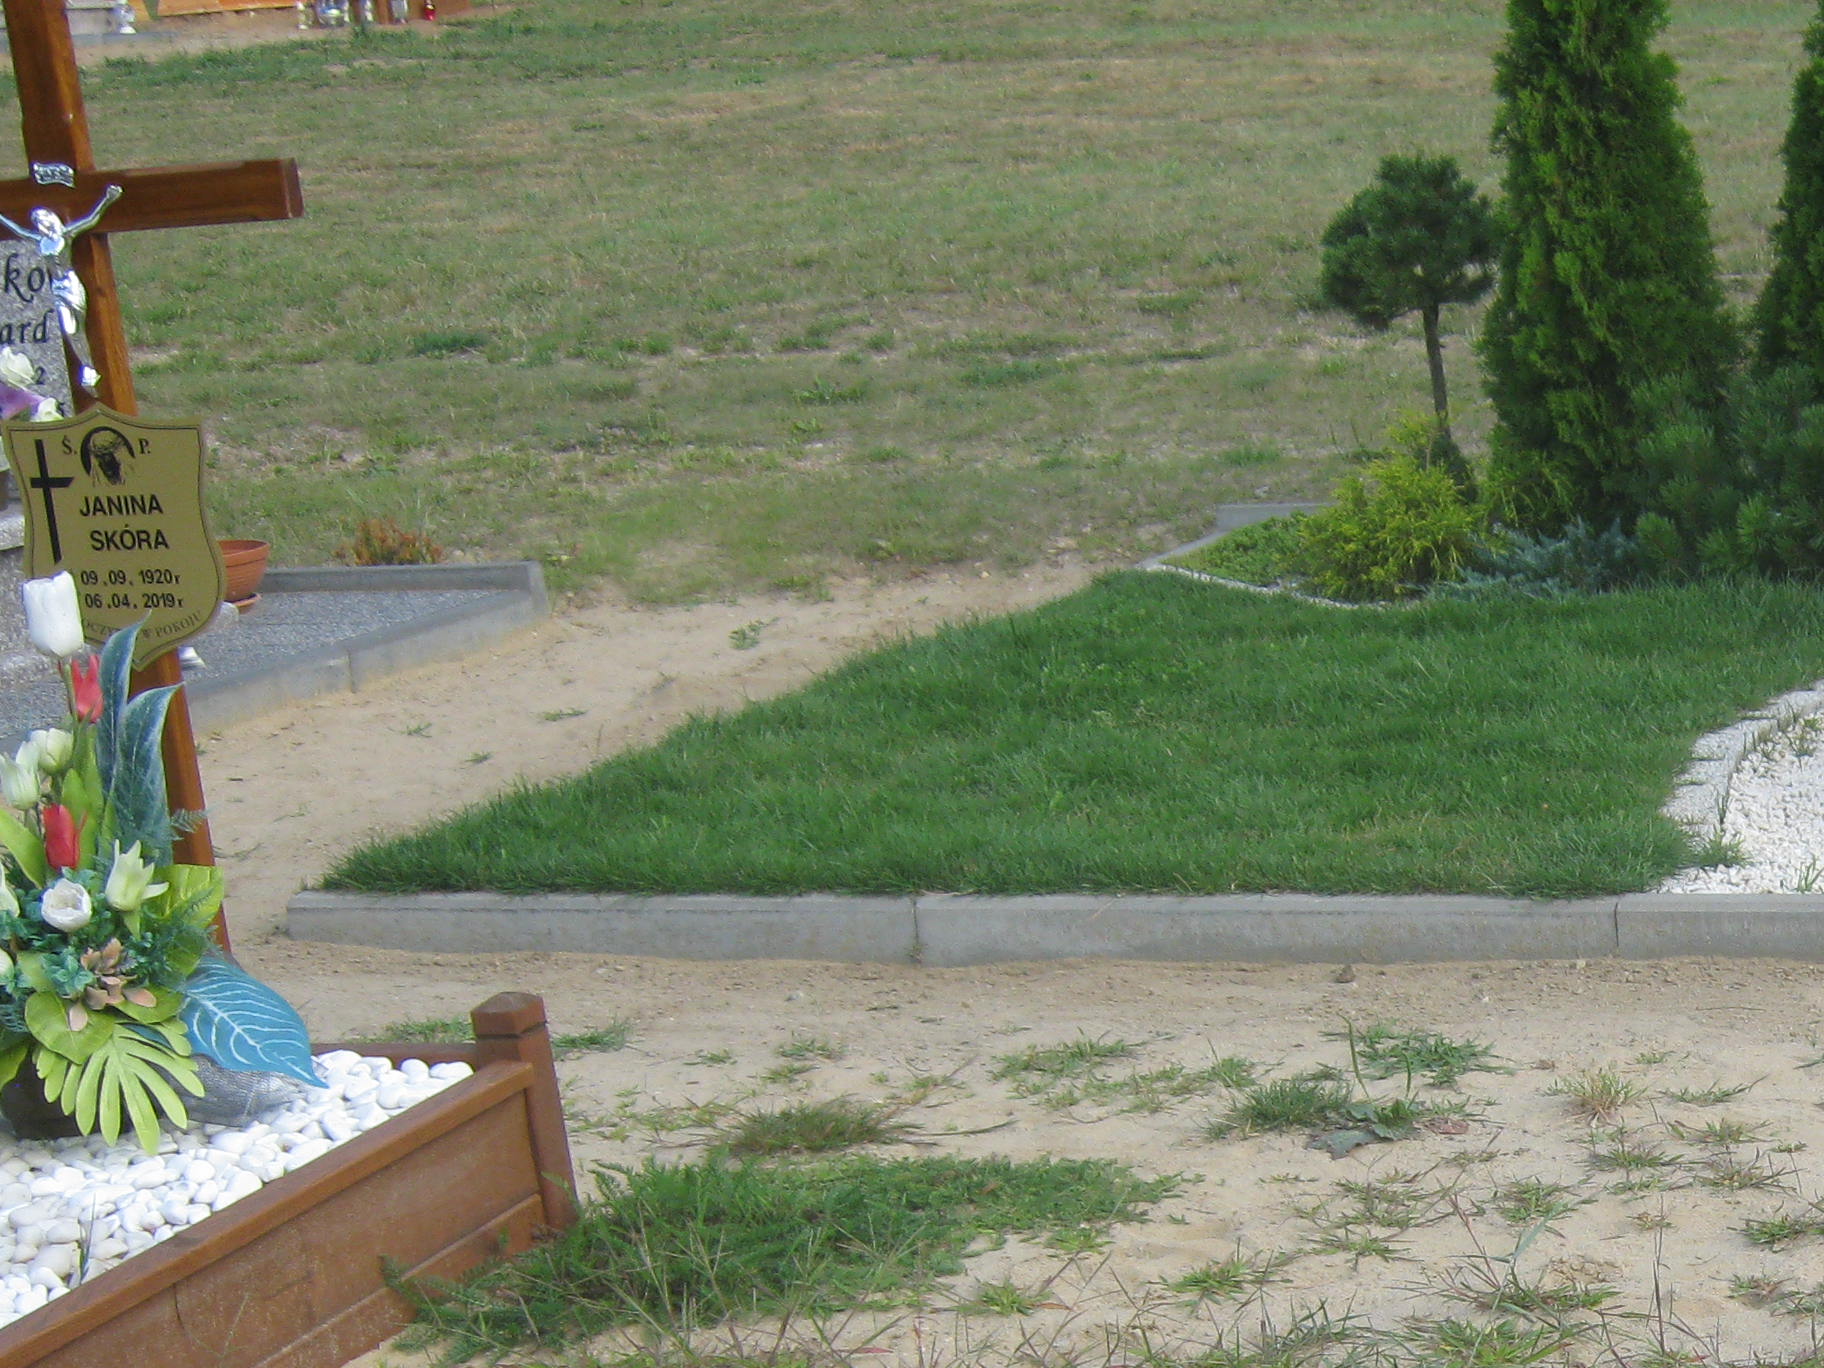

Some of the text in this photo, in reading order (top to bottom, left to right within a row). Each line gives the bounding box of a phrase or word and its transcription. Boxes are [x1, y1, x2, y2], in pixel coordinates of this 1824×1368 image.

[137, 438, 151, 454] P.
[80, 494, 164, 517] JANINA
[90, 524, 170, 551] SKÓRA
